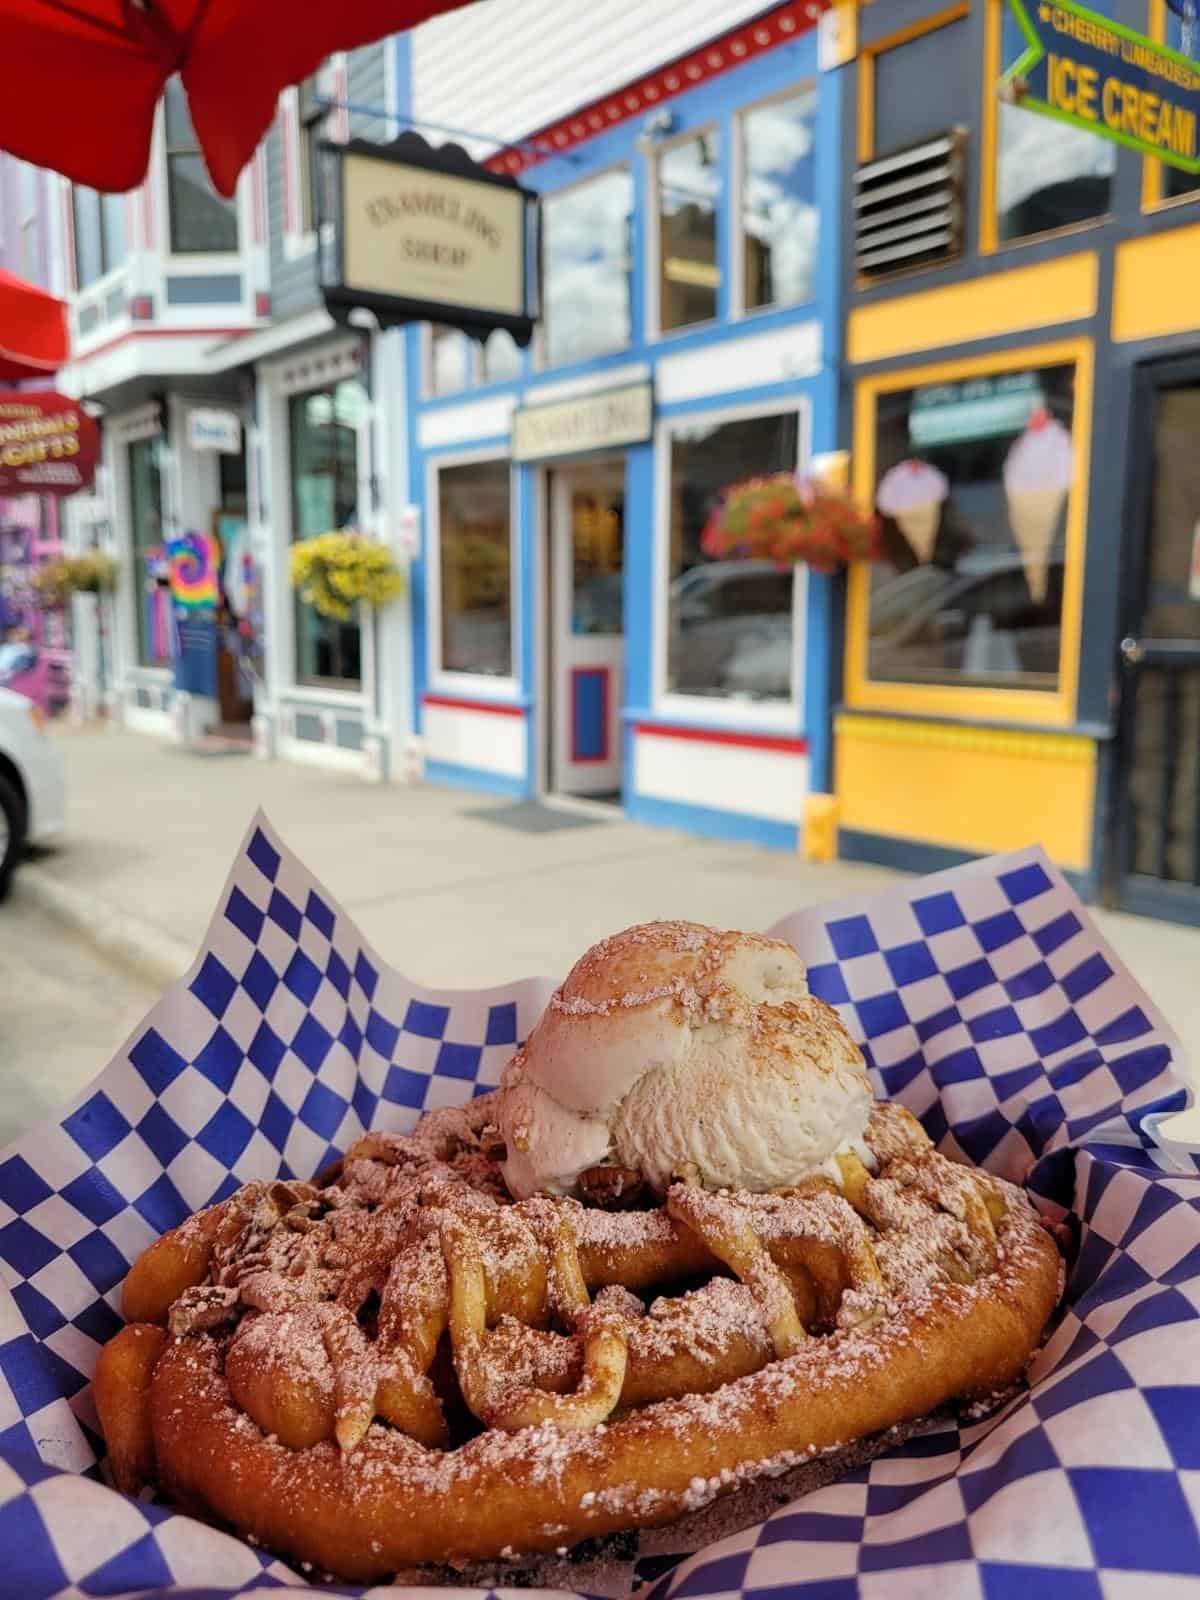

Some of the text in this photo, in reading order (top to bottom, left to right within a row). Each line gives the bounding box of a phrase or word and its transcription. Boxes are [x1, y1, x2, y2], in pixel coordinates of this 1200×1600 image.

[1051, 7, 1120, 56] CHERRY
[1046, 52, 1196, 158] ICE CREAM
